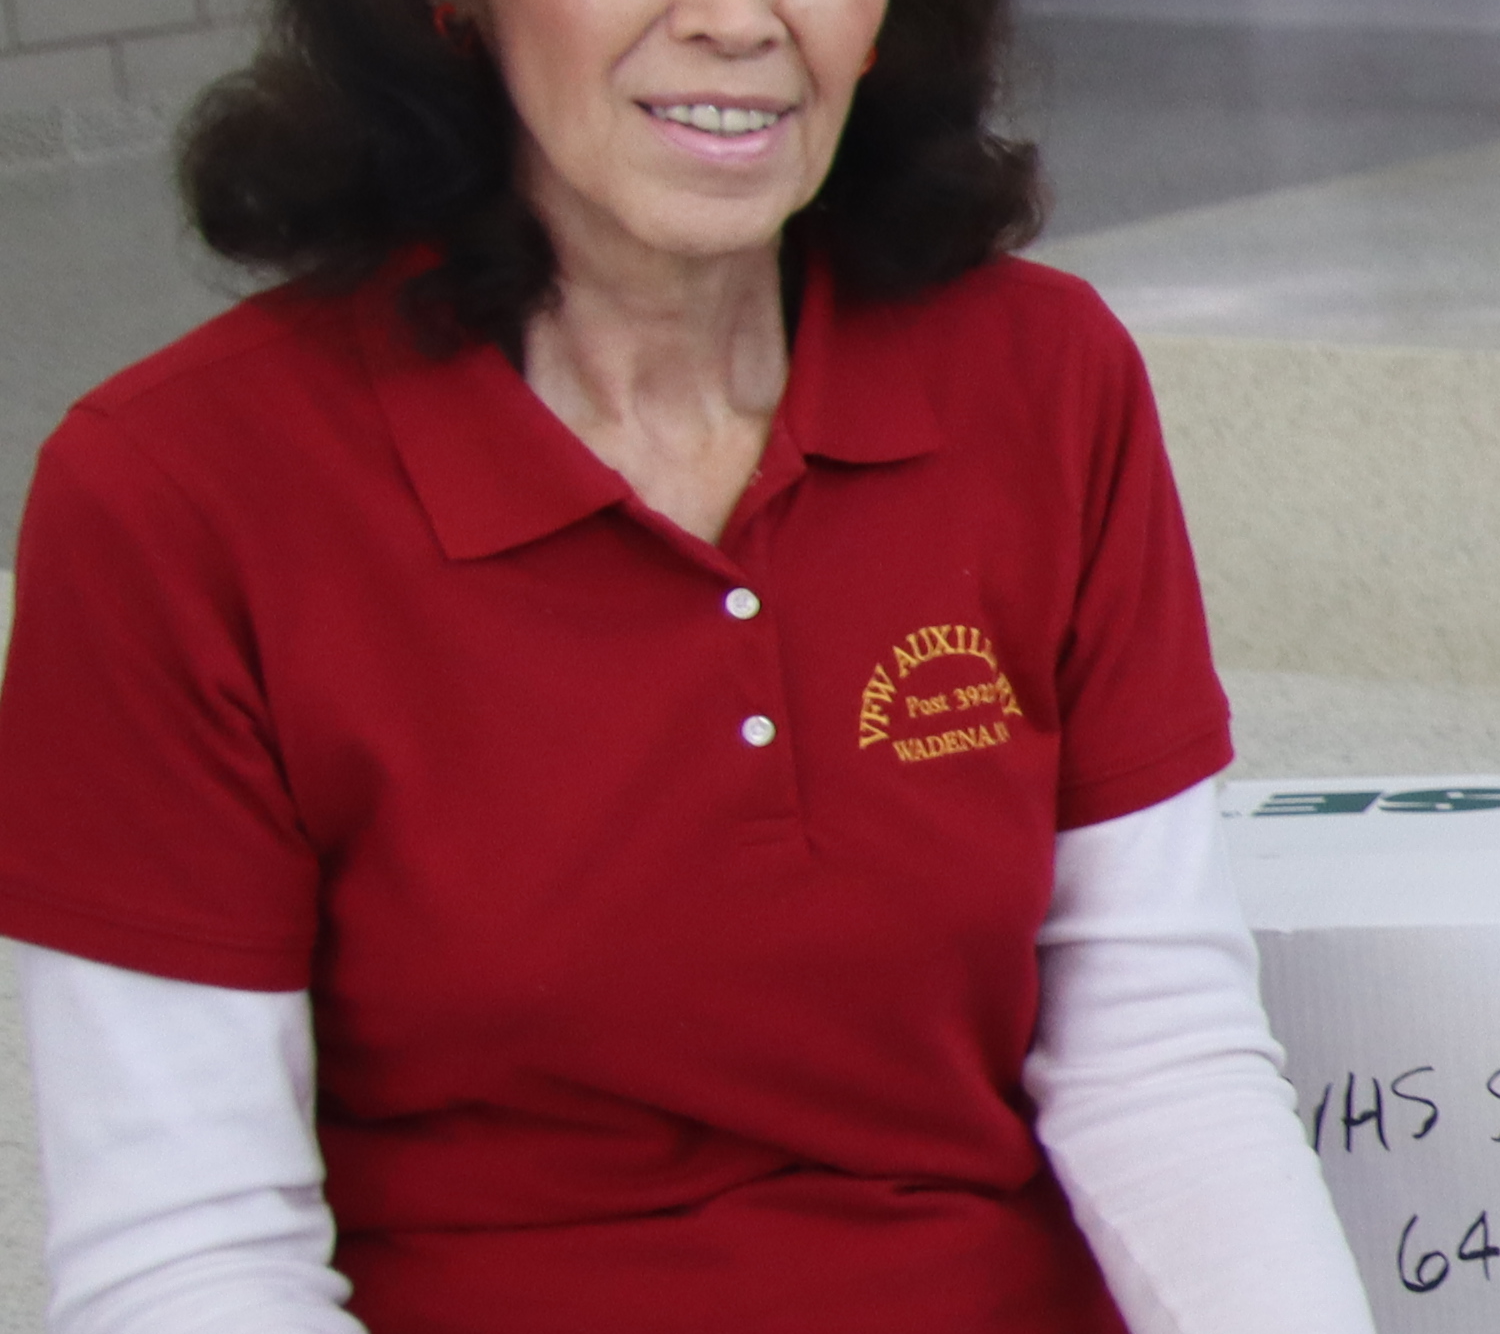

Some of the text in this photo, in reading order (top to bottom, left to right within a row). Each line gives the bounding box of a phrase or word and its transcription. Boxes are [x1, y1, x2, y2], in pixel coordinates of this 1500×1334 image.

[859, 663, 897, 749] VFW
[905, 693, 951, 719] Post
[1396, 1210, 1500, 1295] 64
